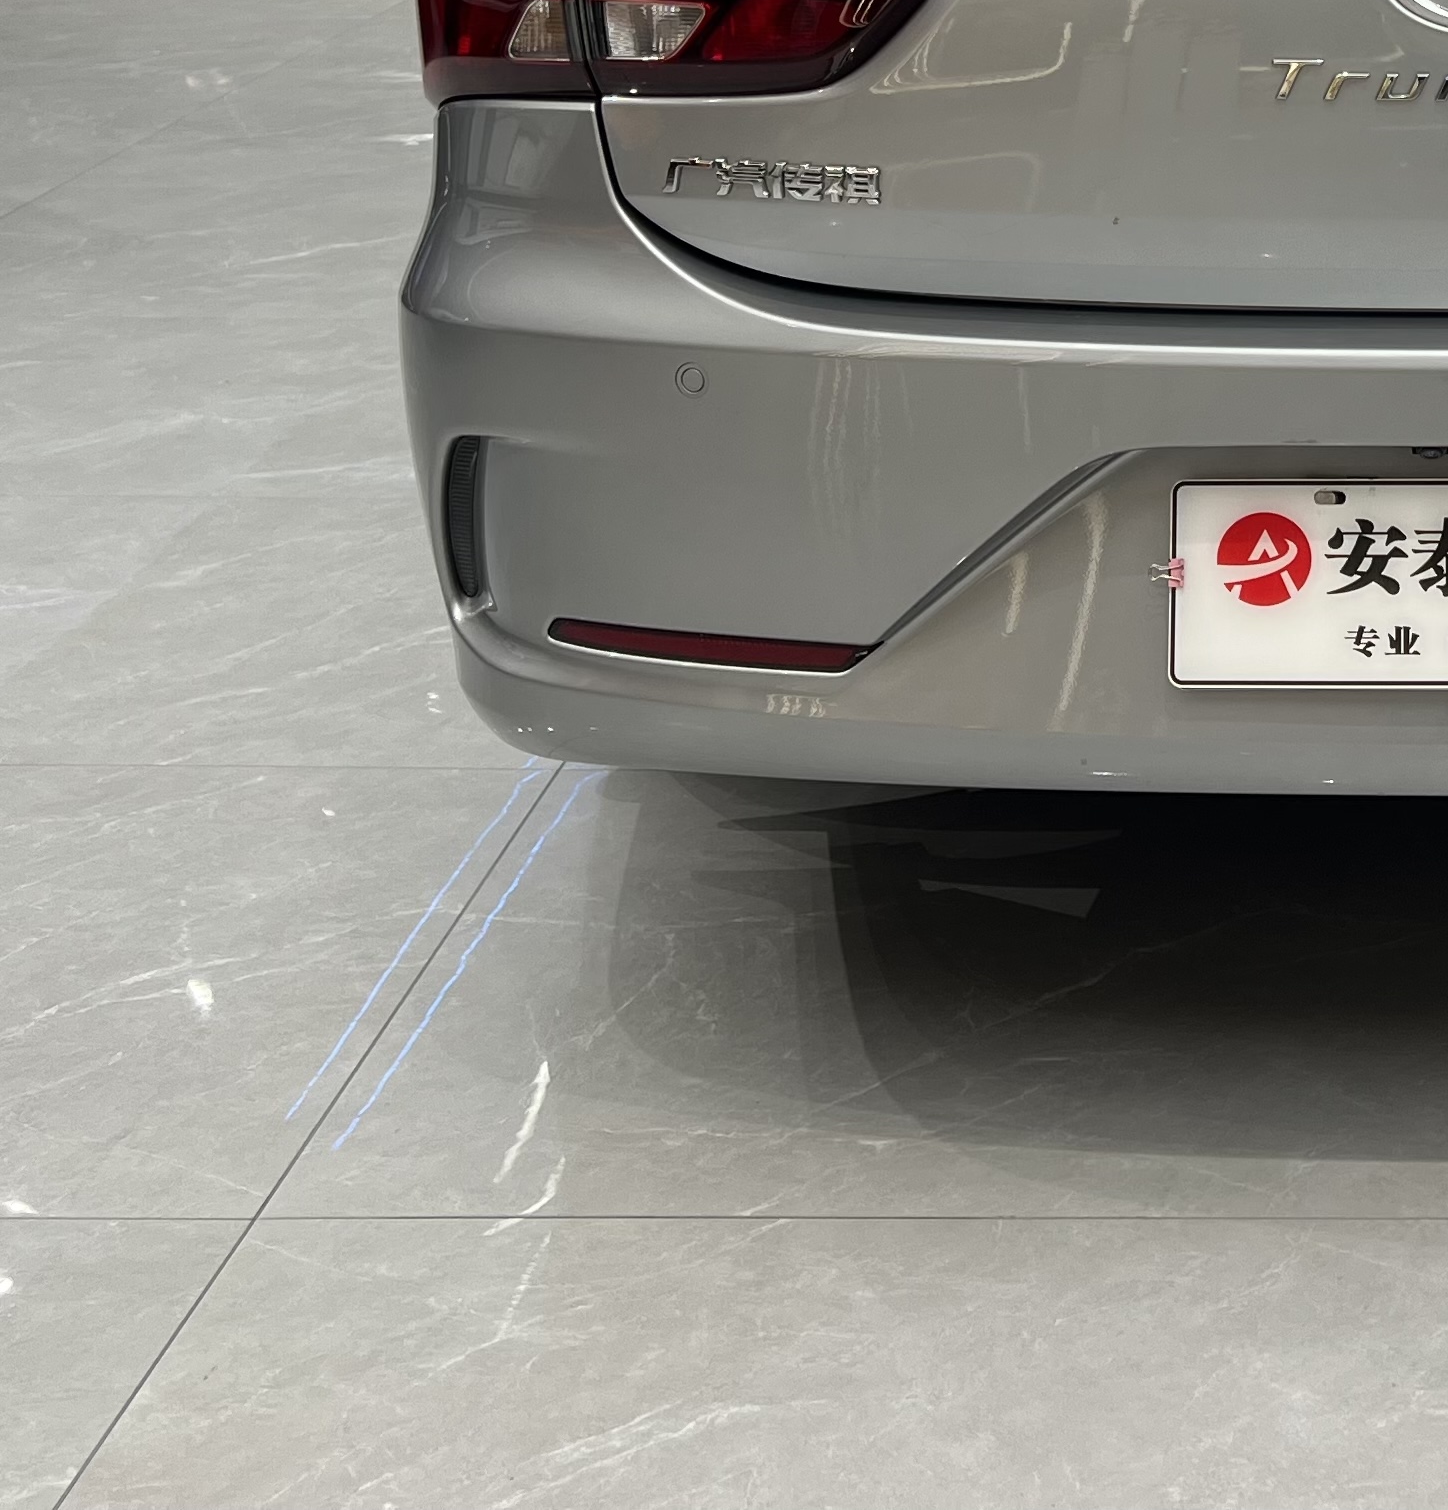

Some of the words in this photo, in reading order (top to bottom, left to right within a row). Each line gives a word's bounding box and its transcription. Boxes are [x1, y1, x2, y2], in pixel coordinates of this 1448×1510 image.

[662, 157, 882, 205] 广汽传祺
[1343, 625, 1422, 659] 专业
